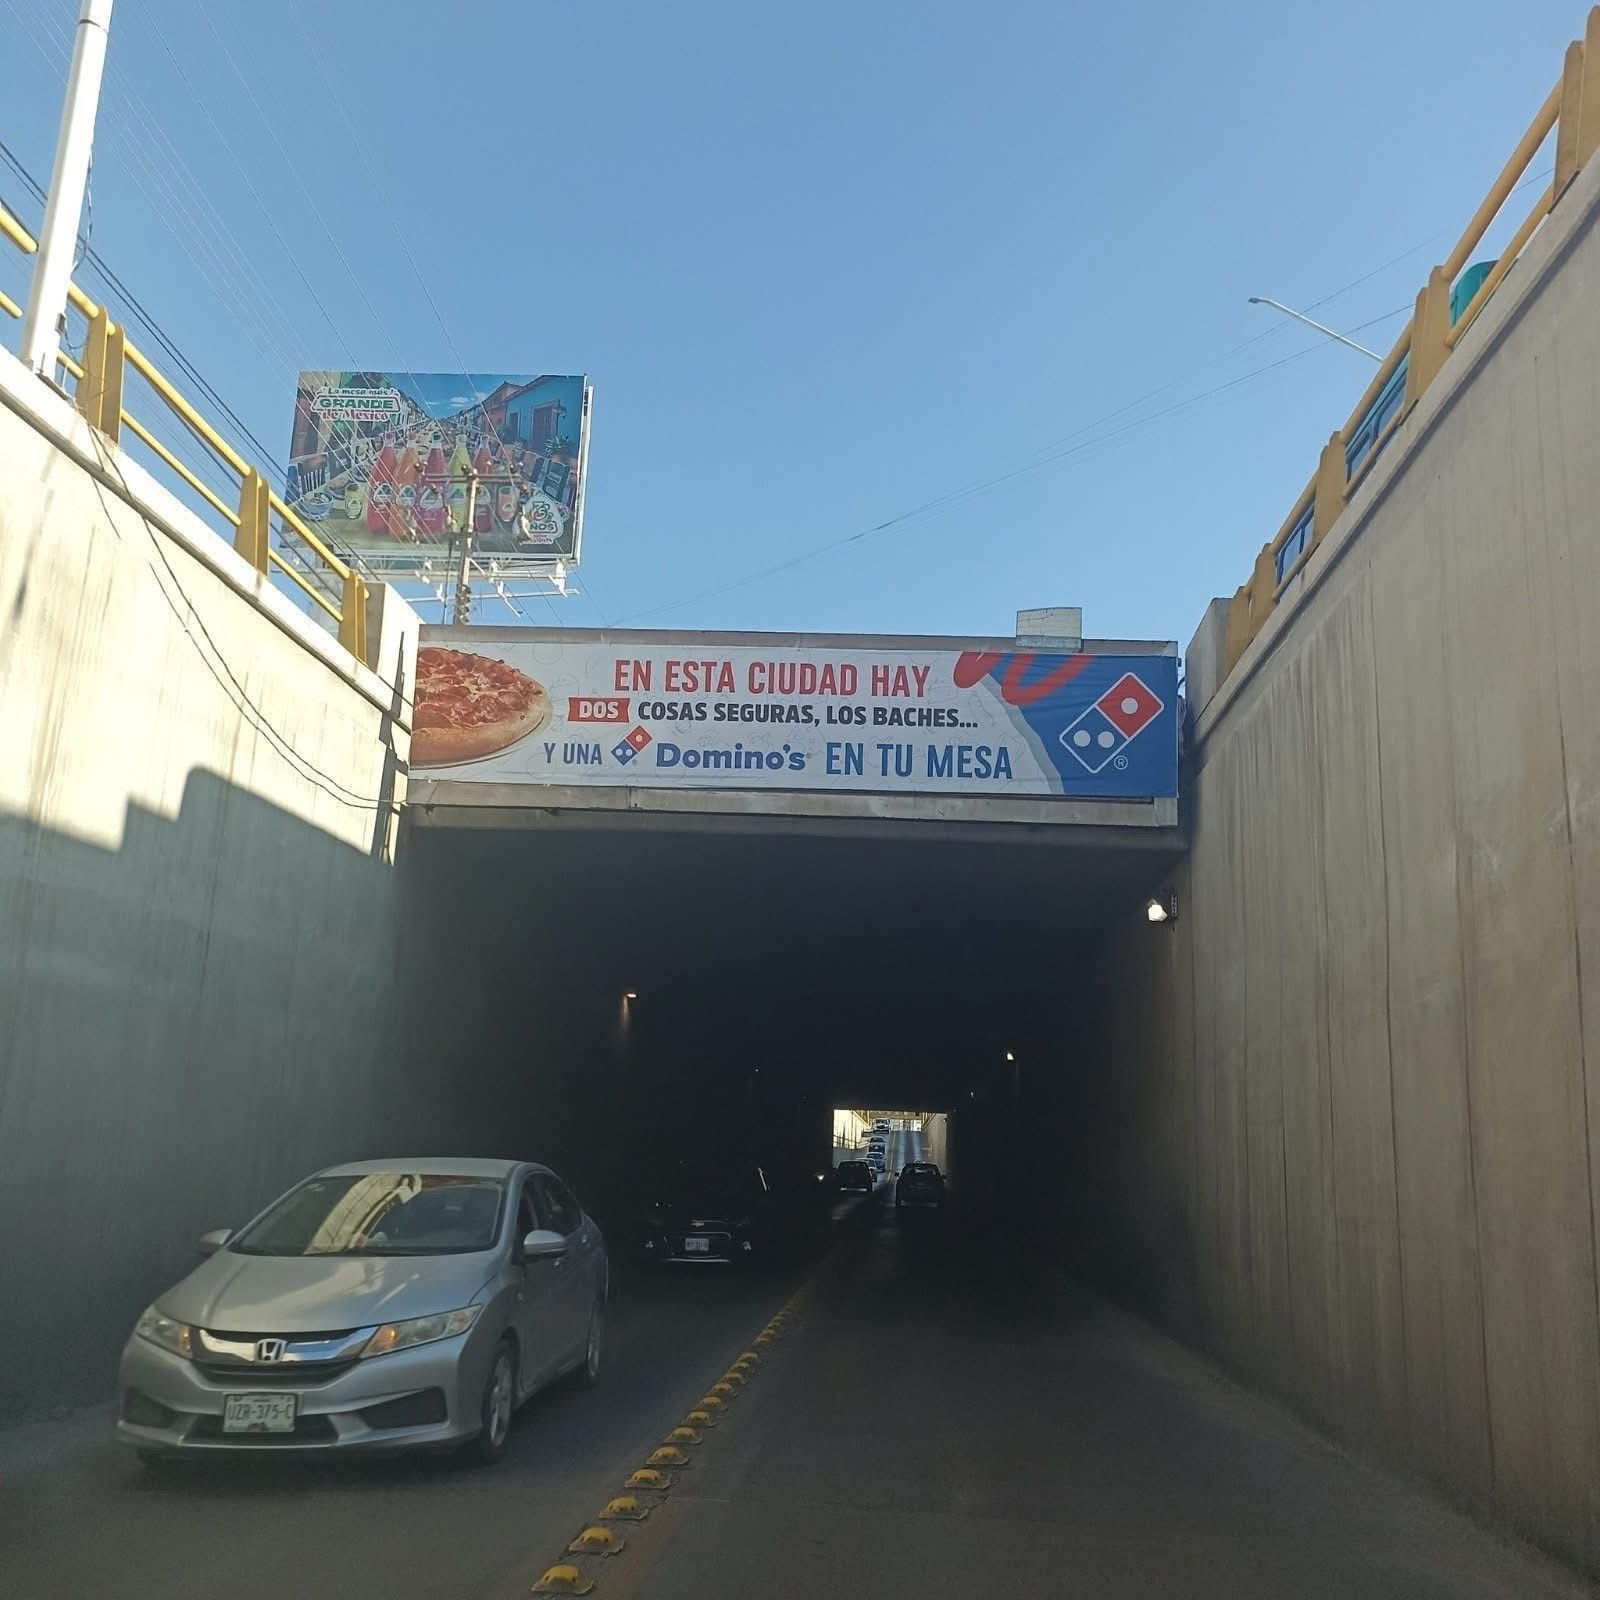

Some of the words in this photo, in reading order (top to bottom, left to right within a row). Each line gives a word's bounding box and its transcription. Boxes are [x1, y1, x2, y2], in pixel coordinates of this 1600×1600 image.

[320, 398, 394, 409] GRANDE
[614, 659, 652, 692] EN
[664, 660, 736, 693] ESTA
[748, 661, 858, 696] CIUDAD
[871, 664, 931, 698] HAY
[578, 701, 619, 719] DOS
[637, 701, 708, 721] COSAS
[713, 703, 820, 727] SEGURAS,
[826, 705, 867, 726] LOS
[873, 707, 978, 728] BACHES...
[543, 742, 556, 764] Y
[563, 742, 603, 765] UNA
[656, 742, 806, 771] Domino's
[826, 741, 864, 776] EN
[876, 743, 913, 777] TU
[926, 744, 1013, 780] MESA
